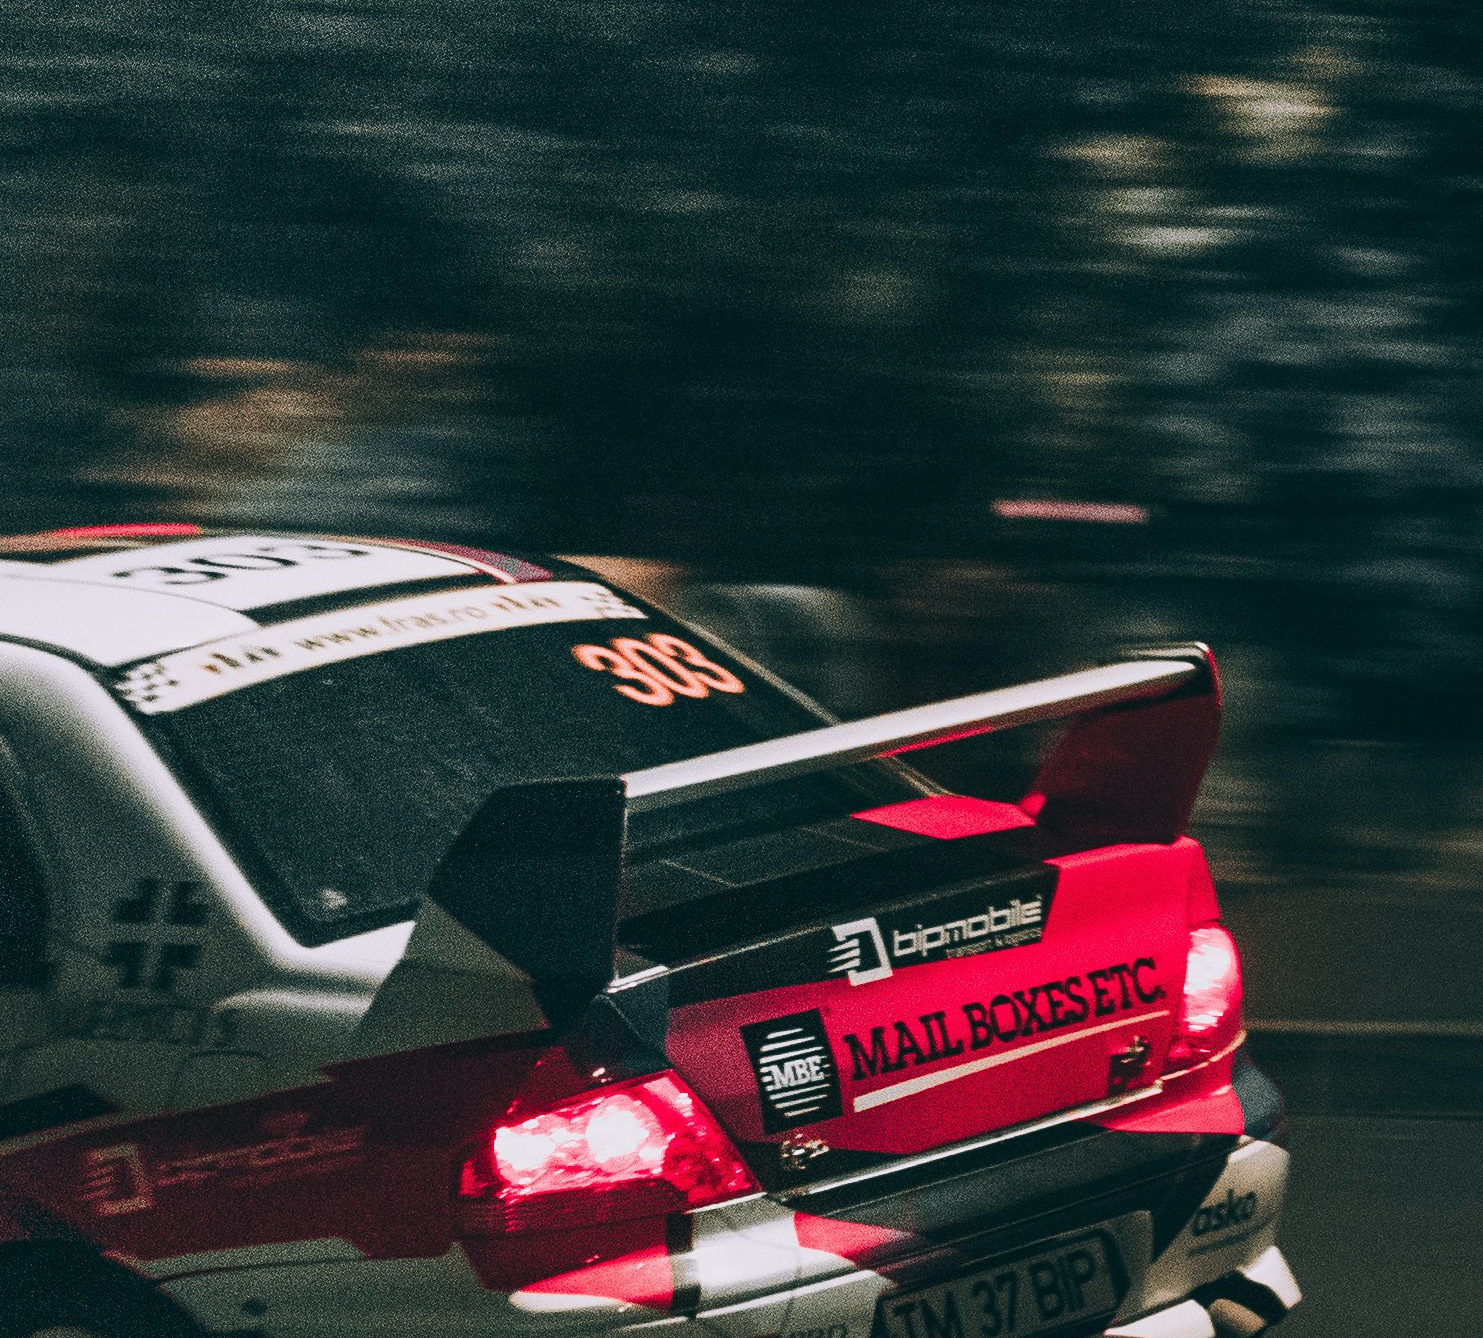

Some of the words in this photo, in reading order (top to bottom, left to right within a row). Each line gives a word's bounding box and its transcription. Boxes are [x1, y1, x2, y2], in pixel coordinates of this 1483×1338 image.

[572, 632, 747, 707] 303
[892, 896, 1042, 957] bipmobile
[843, 1011, 964, 1080] MAIL
[964, 975, 1090, 1051] BOXES
[769, 1055, 825, 1090] MBE
[971, 1271, 1019, 1337] 37
[1031, 1248, 1097, 1322] BIP
